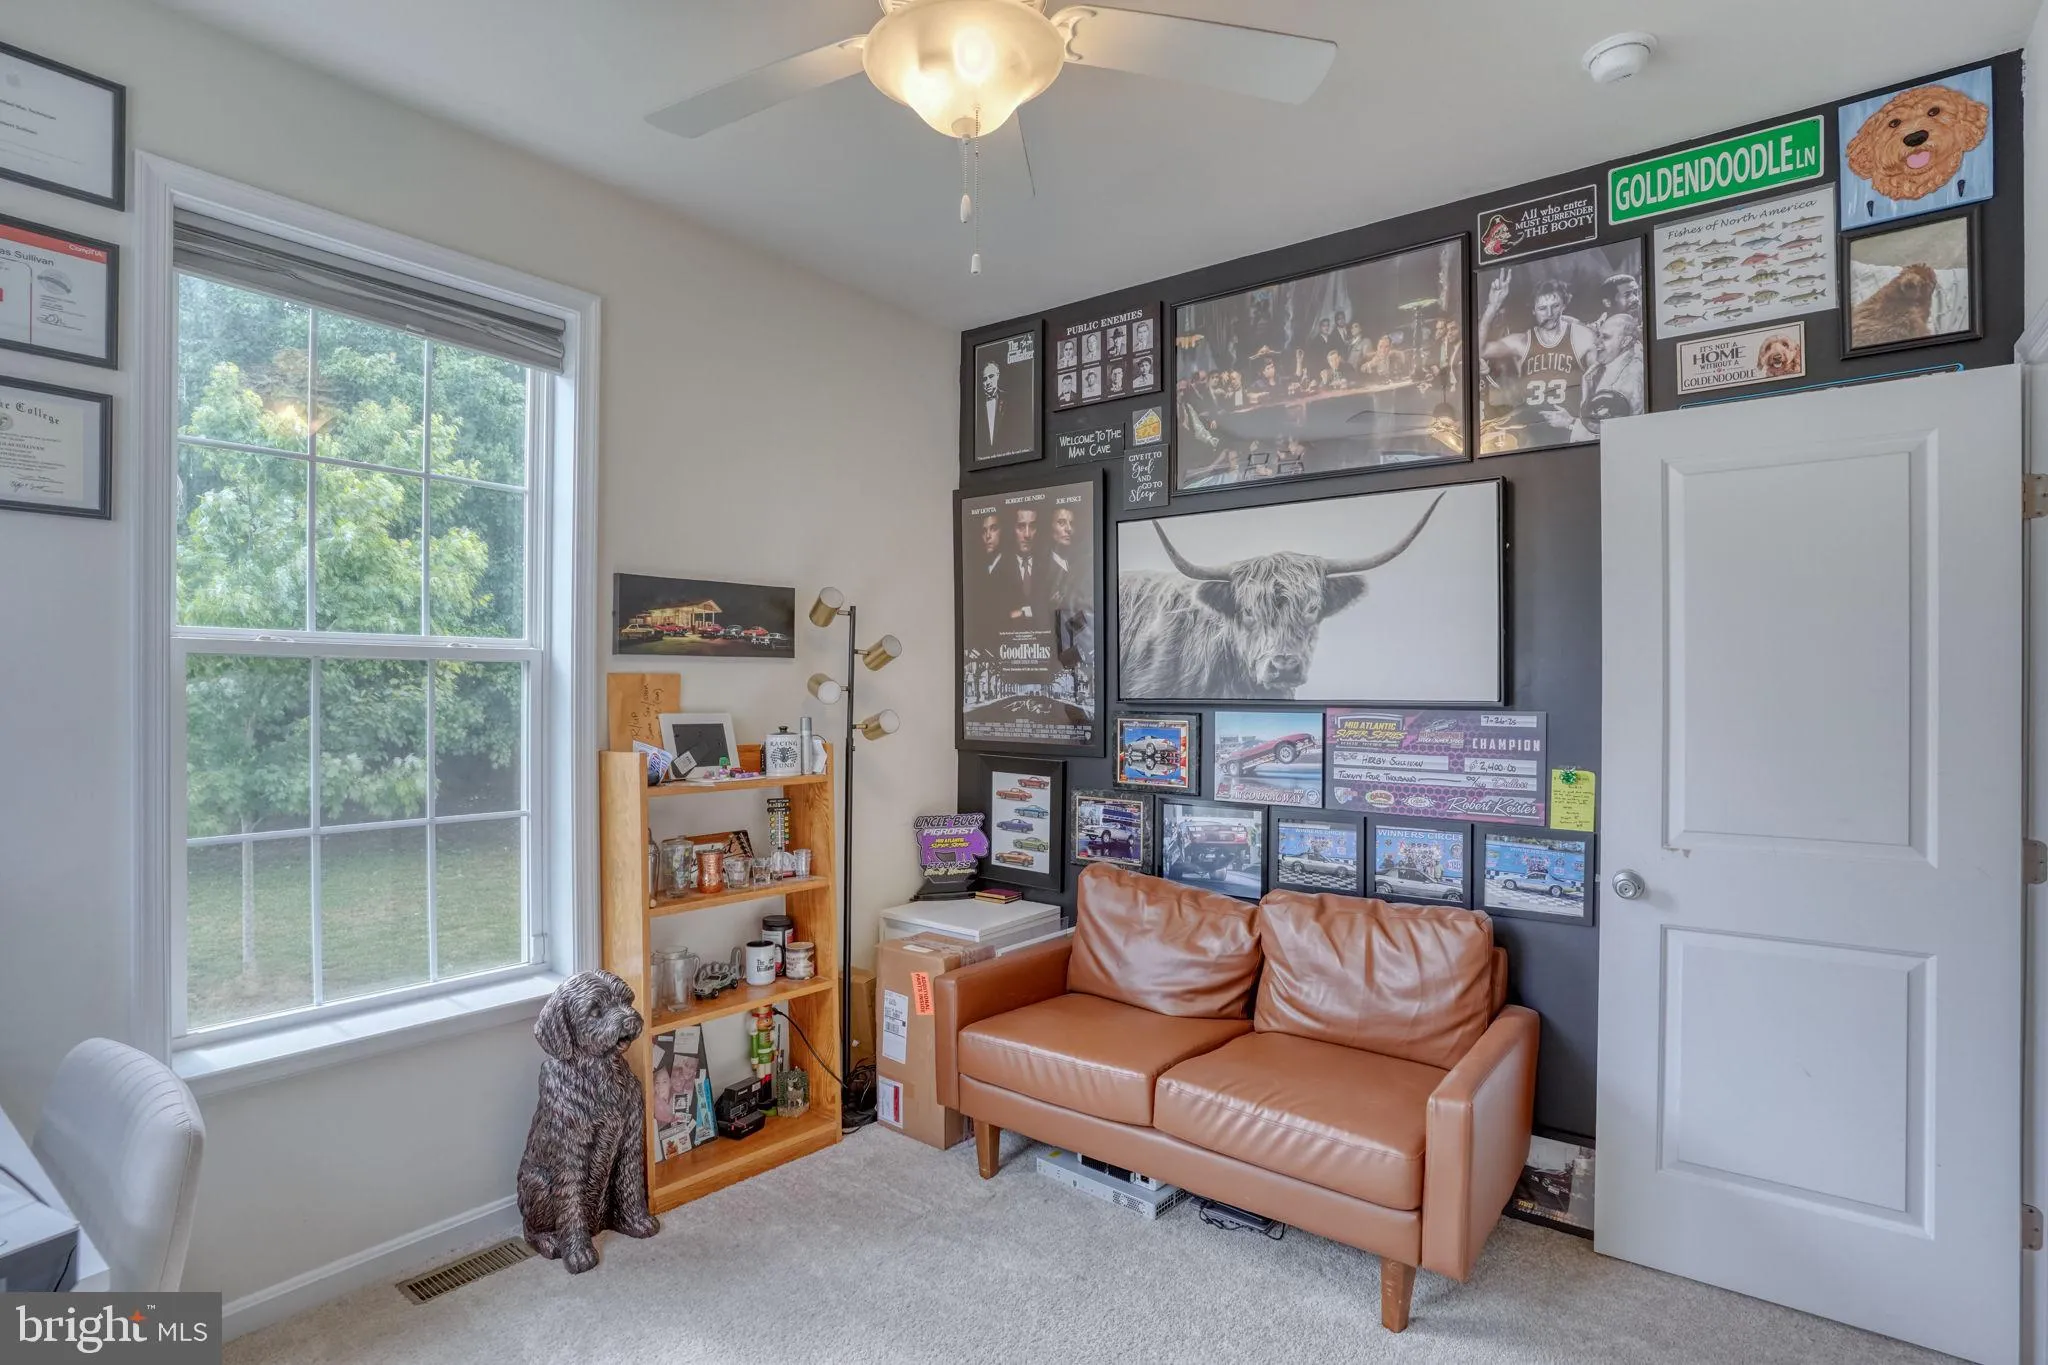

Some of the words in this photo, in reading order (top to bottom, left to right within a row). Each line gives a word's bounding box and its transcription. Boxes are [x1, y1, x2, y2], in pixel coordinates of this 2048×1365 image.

[1615, 135, 1793, 211] GOLDENDOODLE
[1796, 146, 1816, 169] LN
[1515, 217, 1541, 230] MUST
[1542, 205, 1594, 223] SURRENDER
[1521, 208, 1538, 221] All
[1540, 204, 1561, 216] who
[1563, 199, 1588, 211] enter
[1524, 225, 1549, 238] THE
[1551, 214, 1595, 232] BOOTY
[1667, 226, 1703, 240] Fishes
[1705, 221, 1719, 231] of
[1720, 213, 1758, 228] North
[1760, 200, 1818, 218] America
[14, 250, 55, 266] Sullivan
[1066, 320, 1099, 336] PUBLIC
[1101, 309, 1143, 327] ENEMIES
[1527, 353, 1573, 375] CELTICS
[1693, 347, 1746, 365] HOME
[1700, 360, 1732, 370] WITHOUT
[1683, 369, 1757, 388] GOLDENDOODLE
[1526, 378, 1567, 406] 33
[16, 401, 60, 424] College
[1060, 433, 1095, 447] WELCOME
[1069, 447, 1085, 459] MAN
[1129, 453, 1144, 462] GIVE
[1132, 459, 1155, 479] God
[1137, 475, 1152, 483] AND
[1142, 482, 1152, 490] GO
[1129, 486, 1157, 502] Sleep
[1000, 643, 1051, 660] GoodFellas
[1344, 721, 1360, 729] MID
[1360, 721, 1397, 730] ATLANTIC
[1472, 738, 1541, 751] CHAMPION
[1448, 797, 1491, 814] Robert
[1492, 797, 1537, 816] Keister
[915, 815, 948, 828] UNCLE
[950, 814, 983, 827] BUCK
[923, 827, 975, 836] PIGROAST
[1378, 830, 1425, 839] WINNERS
[921, 976, 930, 1010] ADDITIONAL
